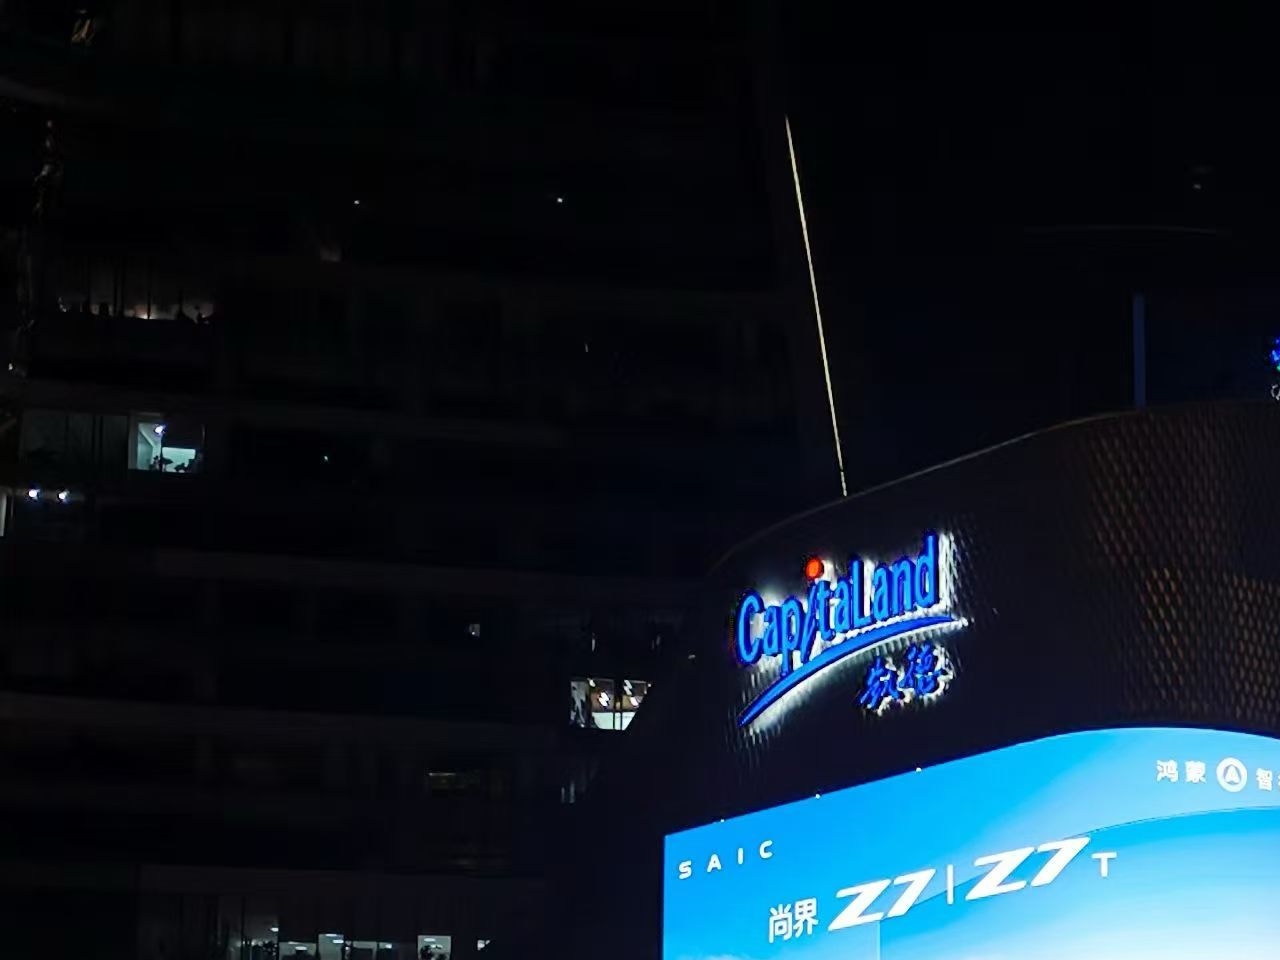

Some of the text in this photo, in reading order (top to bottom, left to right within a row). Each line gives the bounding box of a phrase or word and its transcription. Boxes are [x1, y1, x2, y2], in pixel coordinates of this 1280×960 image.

[736, 531, 940, 679] CapitaLand
[677, 839, 774, 880] SAIC
[768, 898, 819, 943] 尚界
[828, 867, 936, 932] Z7
